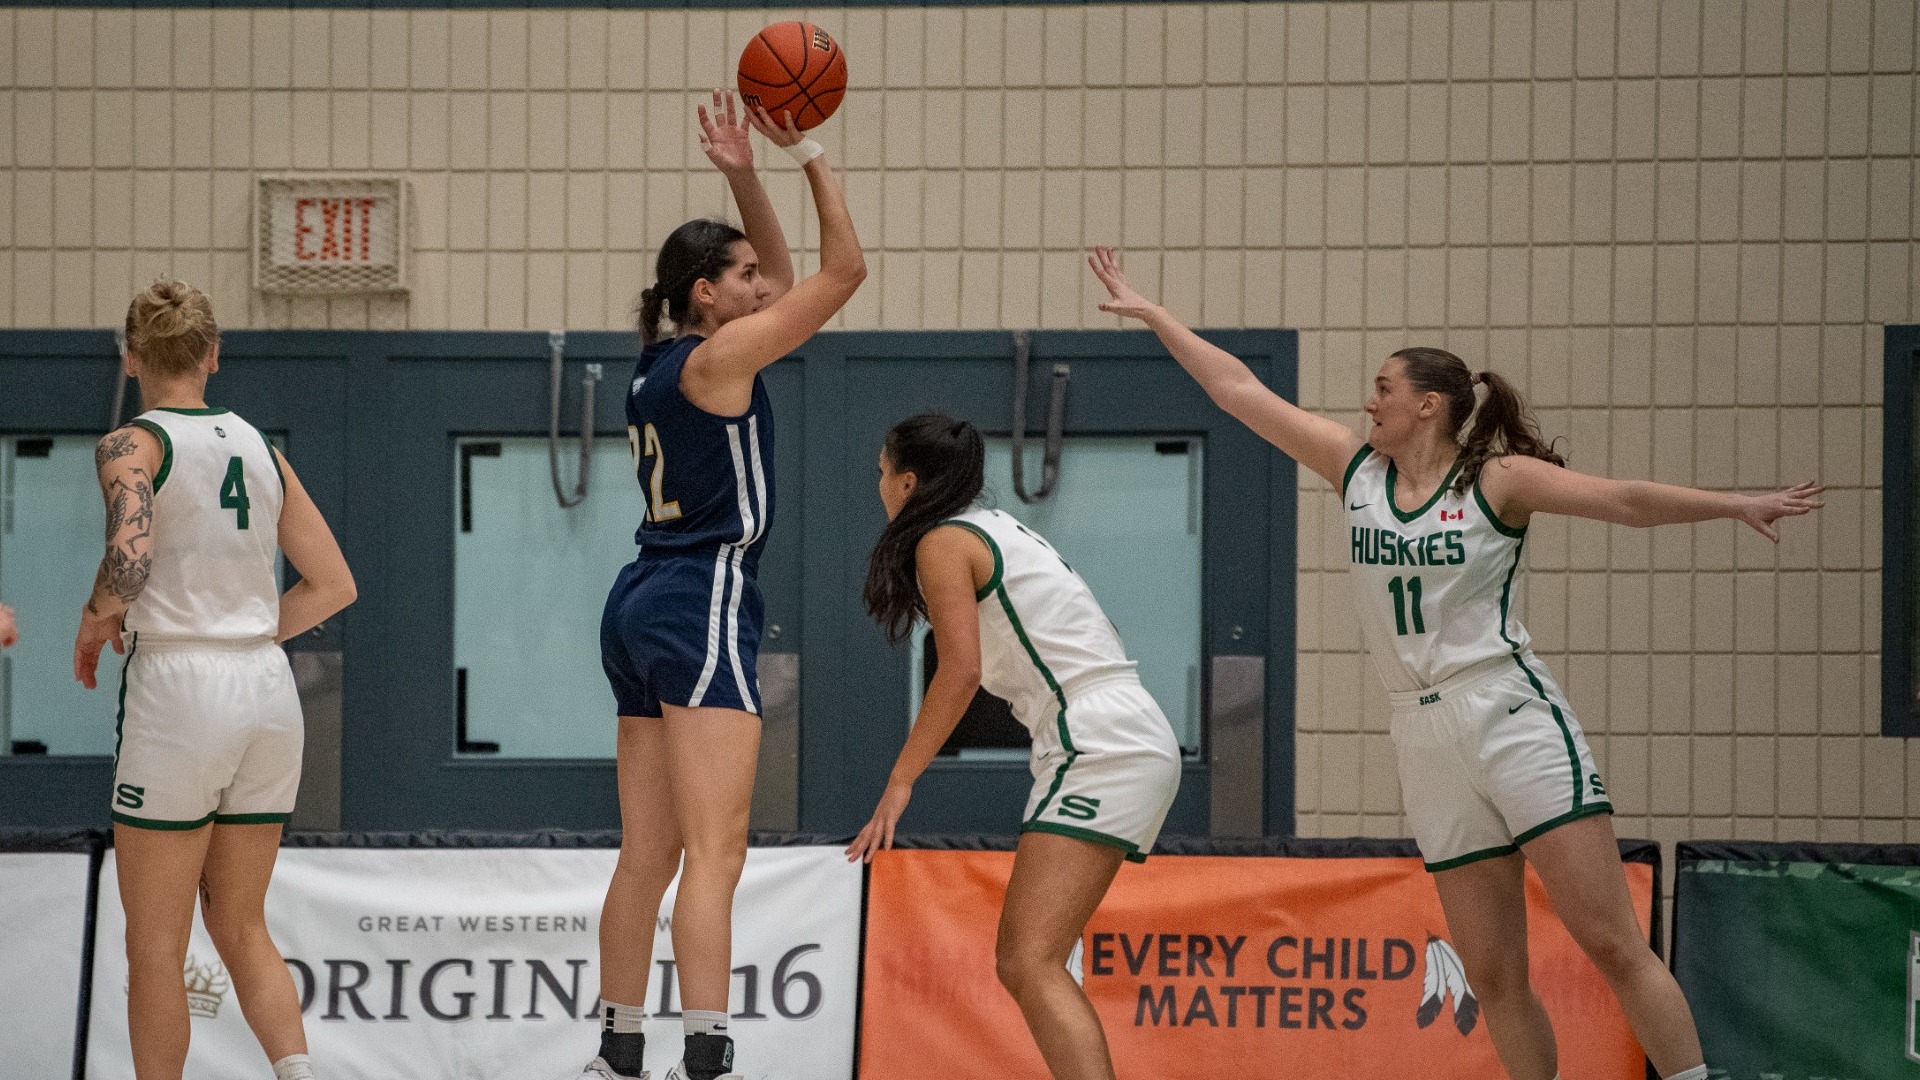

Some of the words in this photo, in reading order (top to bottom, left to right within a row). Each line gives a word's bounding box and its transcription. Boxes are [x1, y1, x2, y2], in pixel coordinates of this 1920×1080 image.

[294, 198, 376, 261] EXIT
[219, 455, 251, 531] 4
[1350, 526, 1466, 567] HUSKIES
[1387, 575, 1426, 636] 11
[1418, 691, 1442, 706] SASK
[115, 782, 146, 810] S
[1056, 793, 1101, 821] S
[357, 915, 445, 933] GREAT
[458, 915, 588, 933] WESTERN
[1090, 932, 1248, 979] EVERY
[1266, 934, 1417, 981] CHILD
[283, 956, 685, 1022] RIGINL
[731, 943, 823, 1021] 16
[1133, 983, 1369, 1031] MATTERS
